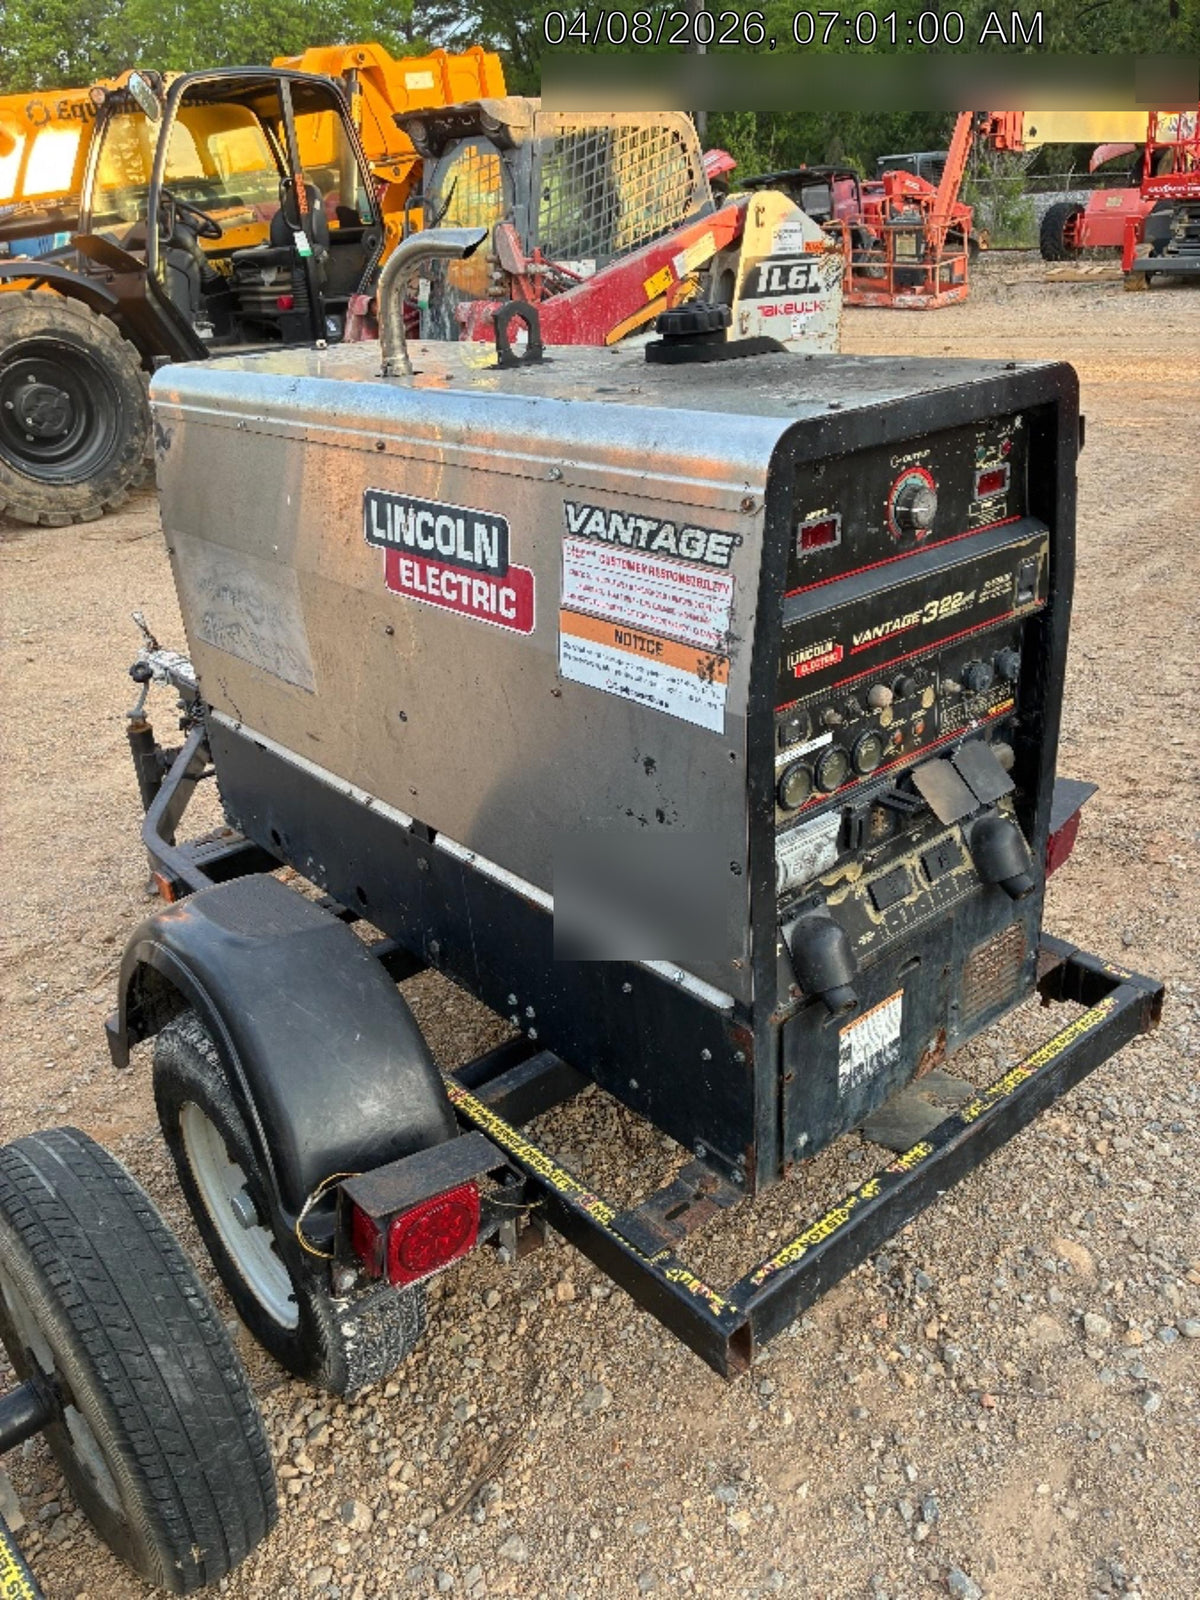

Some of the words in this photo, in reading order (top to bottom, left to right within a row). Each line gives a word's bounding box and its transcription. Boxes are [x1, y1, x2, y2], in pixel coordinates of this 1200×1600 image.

[370, 499, 499, 568] LINCOLN
[566, 503, 734, 565] VANTAGE
[399, 557, 517, 620] ELECTRIC
[614, 628, 664, 657] NOTICE
[852, 609, 923, 646] VANTAGE
